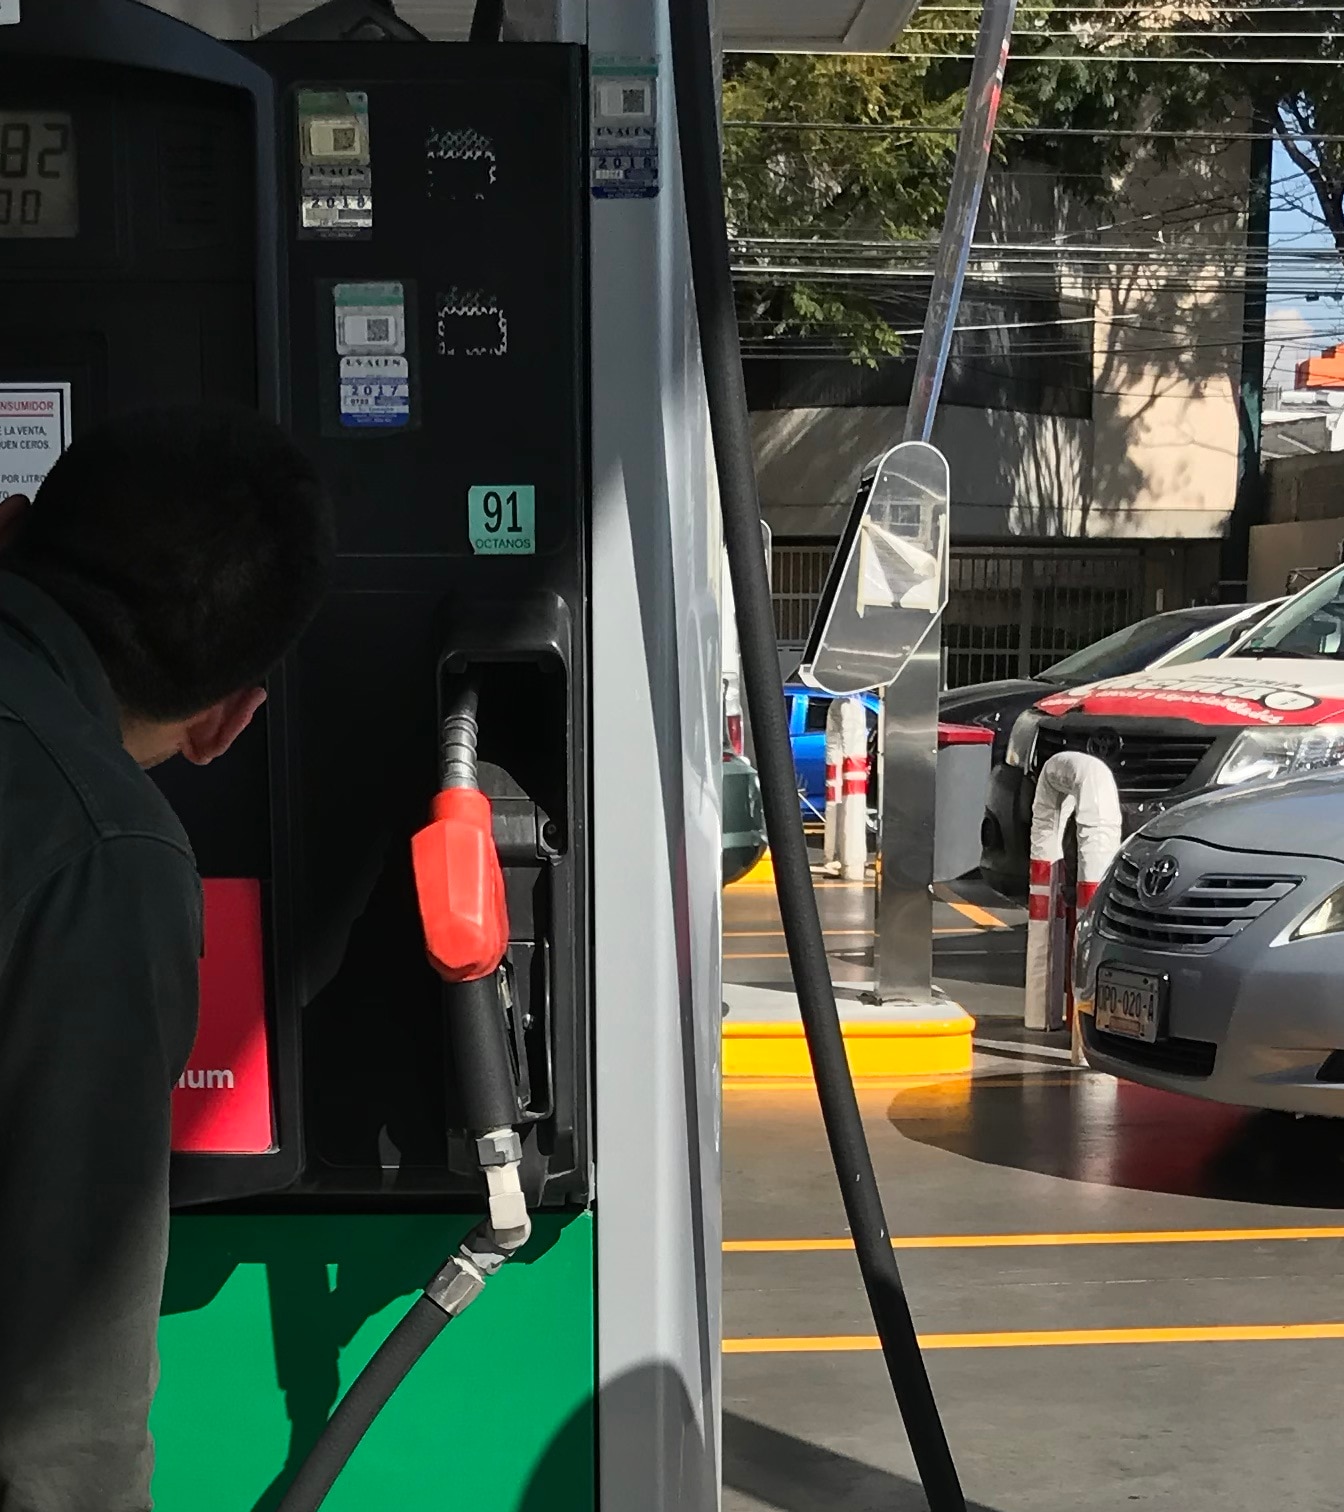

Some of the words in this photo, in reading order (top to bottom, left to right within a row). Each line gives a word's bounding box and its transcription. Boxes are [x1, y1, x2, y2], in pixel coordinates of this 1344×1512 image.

[351, 385, 398, 396] 2017
[5, 426, 16, 436] LA
[1, 475, 20, 484] POR
[483, 490, 523, 533] 91
[475, 539, 531, 549] OCTANOS
